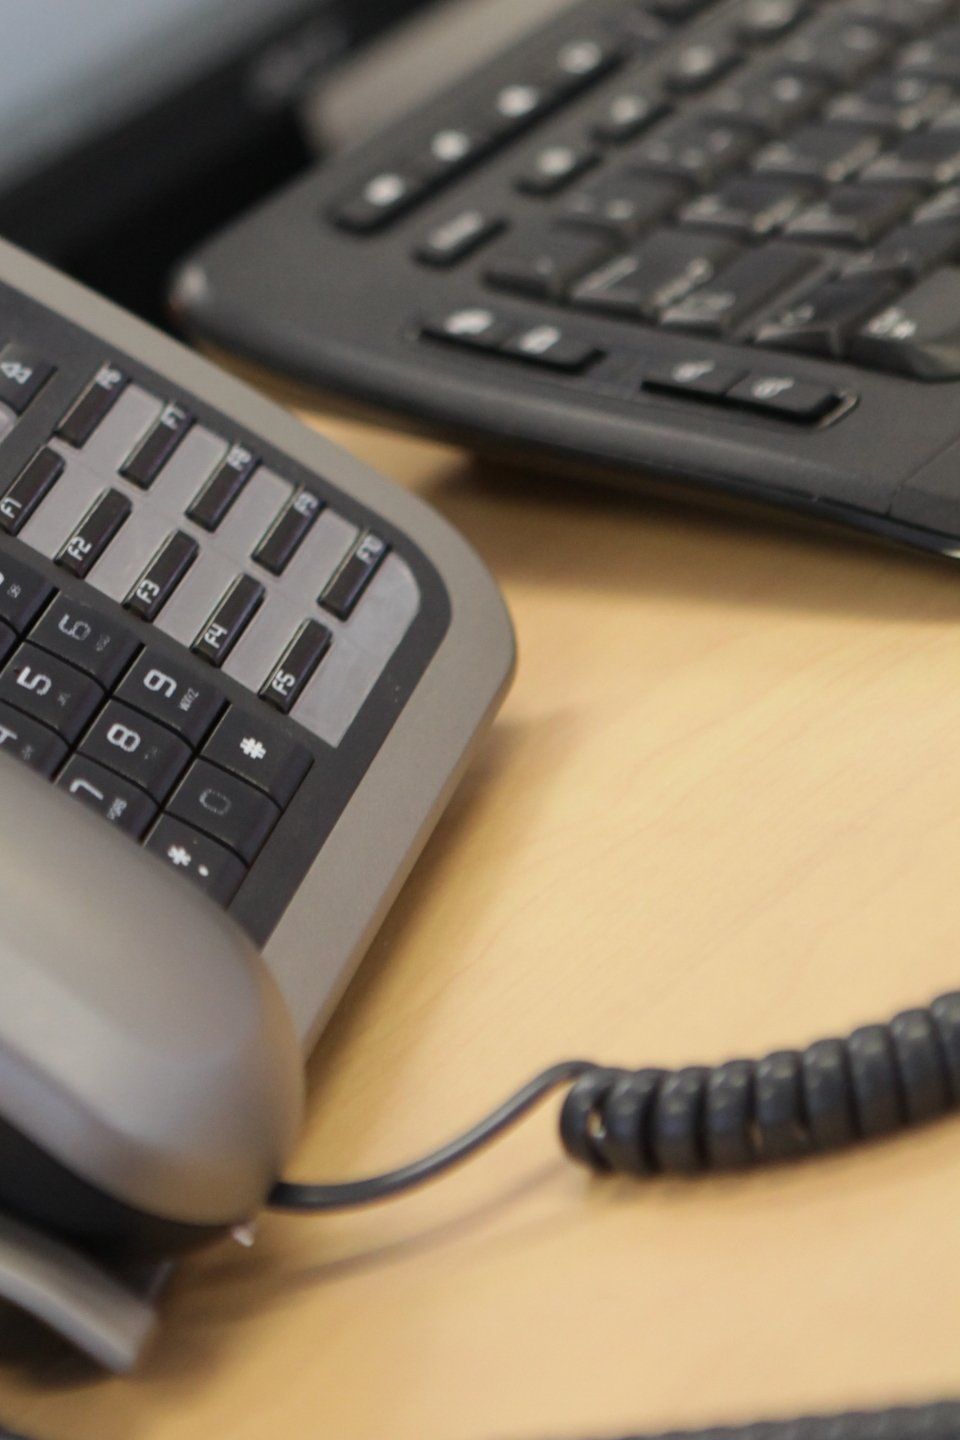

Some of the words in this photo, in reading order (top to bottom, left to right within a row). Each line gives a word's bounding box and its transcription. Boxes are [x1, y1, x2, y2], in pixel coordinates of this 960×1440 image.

[160, 404, 187, 430] F7
[0, 497, 22, 519] F1
[67, 536, 92, 561] F2
[136, 579, 160, 604] F3
[58, 613, 91, 641] 6
[204, 623, 228, 649] F4
[16, 666, 52, 696] 5
[143, 668, 177, 698] 9
[272, 670, 296, 696] F5
[106, 723, 141, 753] 8
[69, 778, 104, 801] 7
